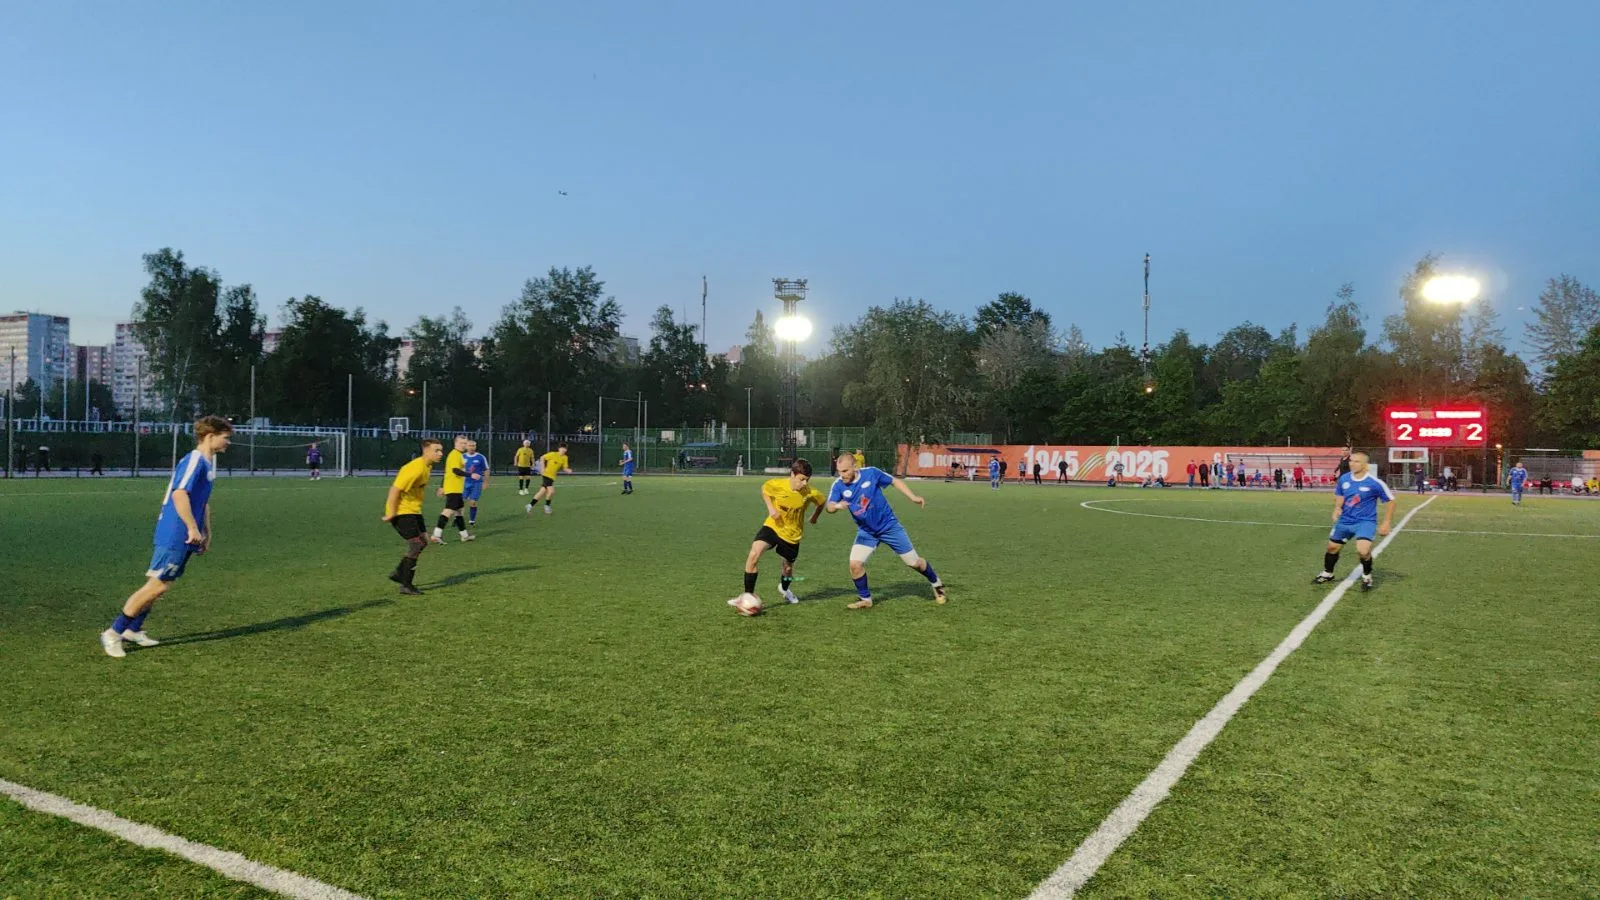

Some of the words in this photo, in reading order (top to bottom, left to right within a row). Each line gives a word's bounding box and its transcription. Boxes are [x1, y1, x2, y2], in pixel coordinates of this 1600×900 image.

[1397, 423, 1413, 441] 2
[1466, 423, 1483, 441] 2
[1024, 445, 1079, 478] 1945
[1105, 450, 1169, 479] 2026
